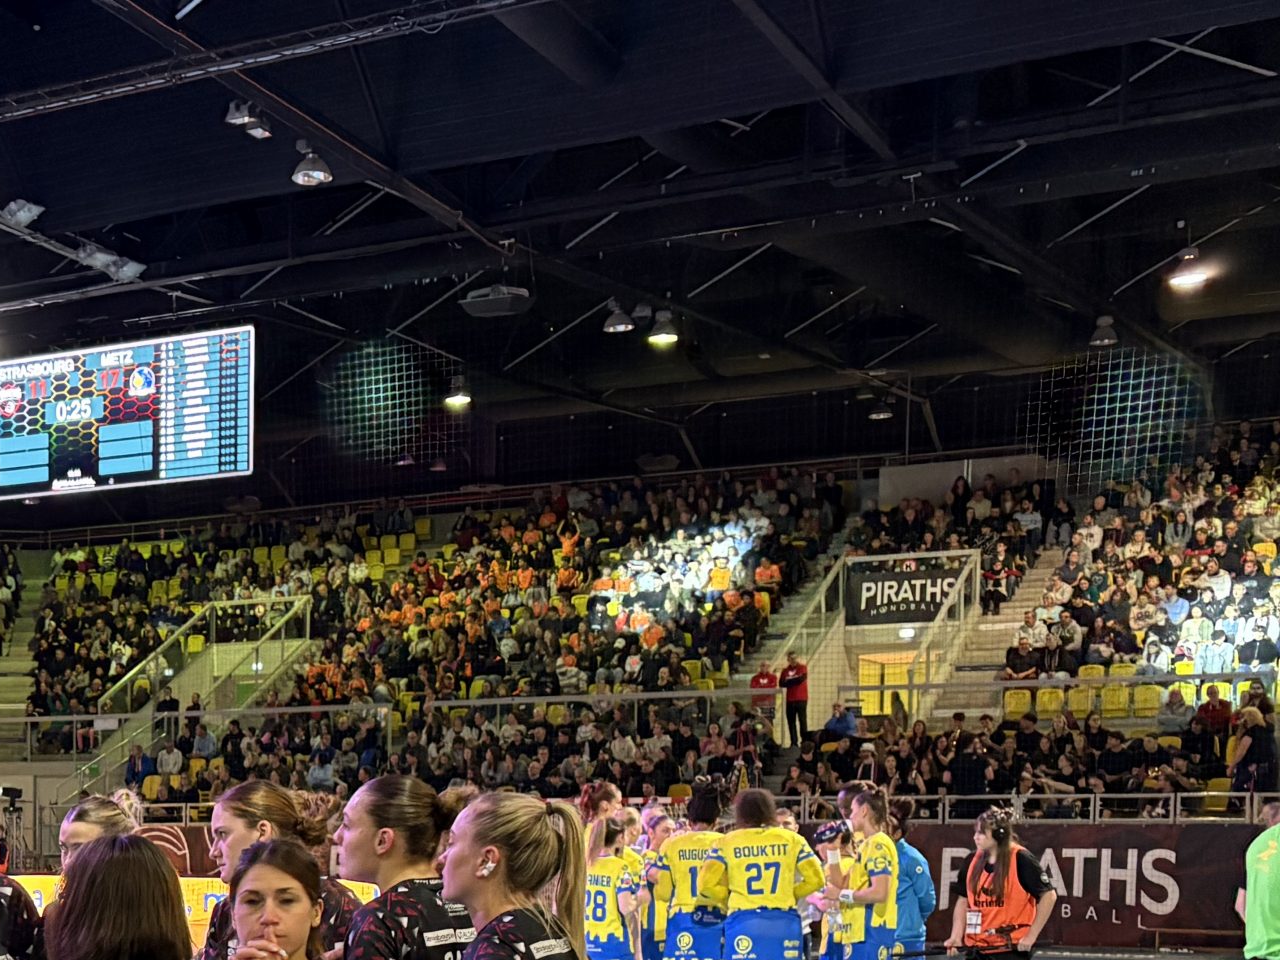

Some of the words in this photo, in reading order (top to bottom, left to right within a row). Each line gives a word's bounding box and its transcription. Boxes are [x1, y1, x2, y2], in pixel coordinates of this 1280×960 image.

[101, 350, 133, 367] METZ
[28, 379, 47, 399] 11
[100, 369, 120, 389] 17
[55, 400, 92, 422] 0:25
[733, 844, 789, 859] BOUKTIT
[744, 861, 781, 895] 27
[939, 847, 1180, 916] PATHS
[1062, 904, 1148, 930] BALL
